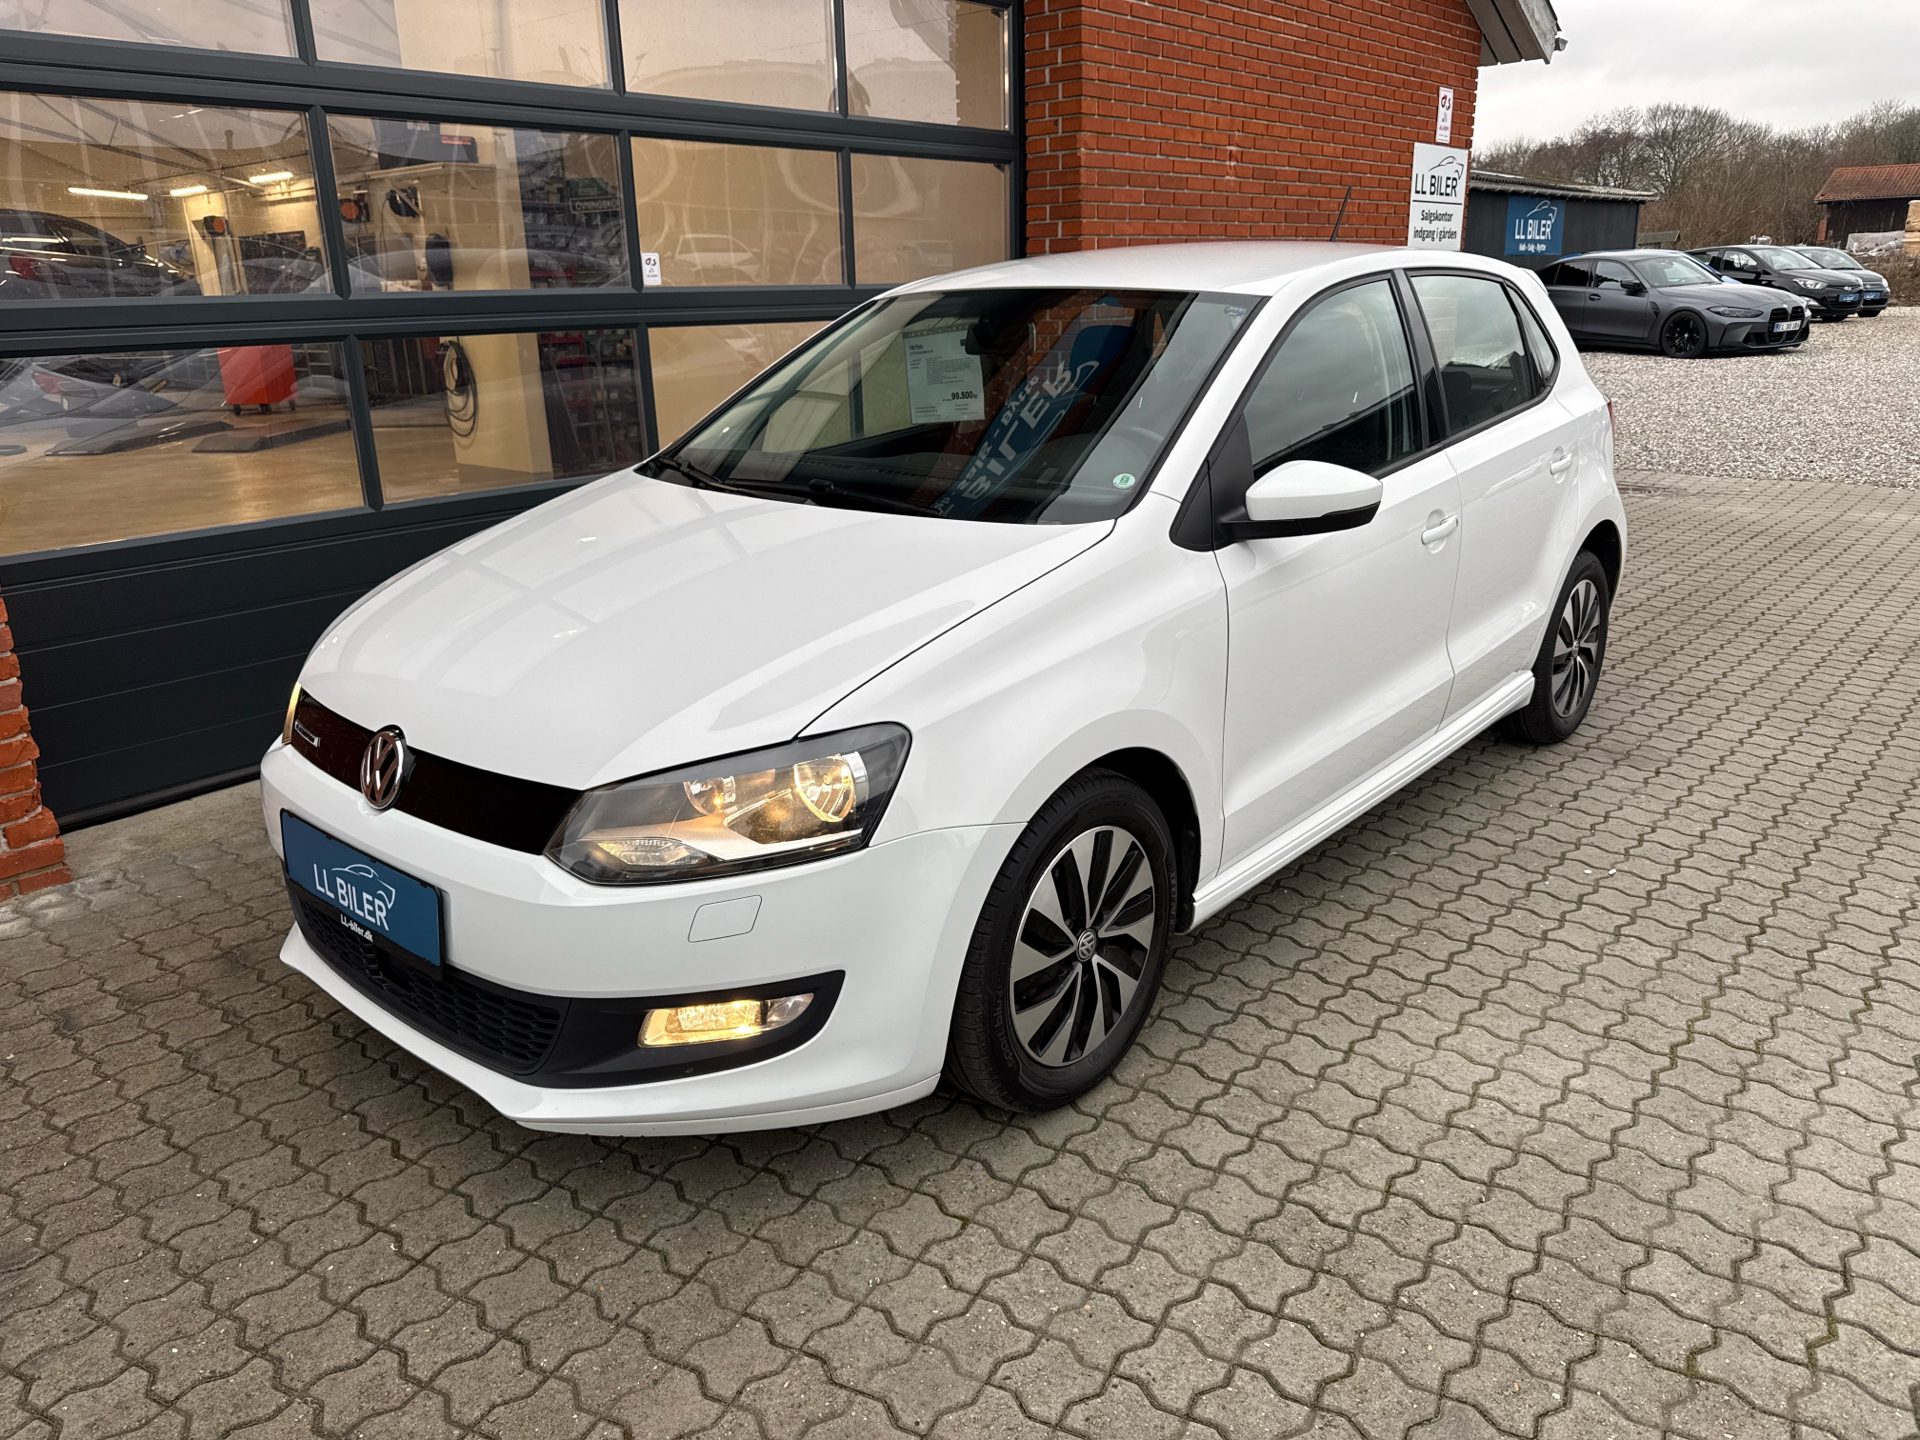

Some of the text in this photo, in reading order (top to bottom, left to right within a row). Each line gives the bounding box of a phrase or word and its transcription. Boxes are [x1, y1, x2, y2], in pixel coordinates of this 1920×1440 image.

[1414, 173, 1458, 197] LL BILER
[1421, 209, 1453, 224] Salgskontor
[1413, 226, 1457, 242] indgang i gården
[1515, 219, 1552, 240] LL BILER
[951, 391, 973, 400] 99.500
[313, 863, 390, 931] LL BILER
